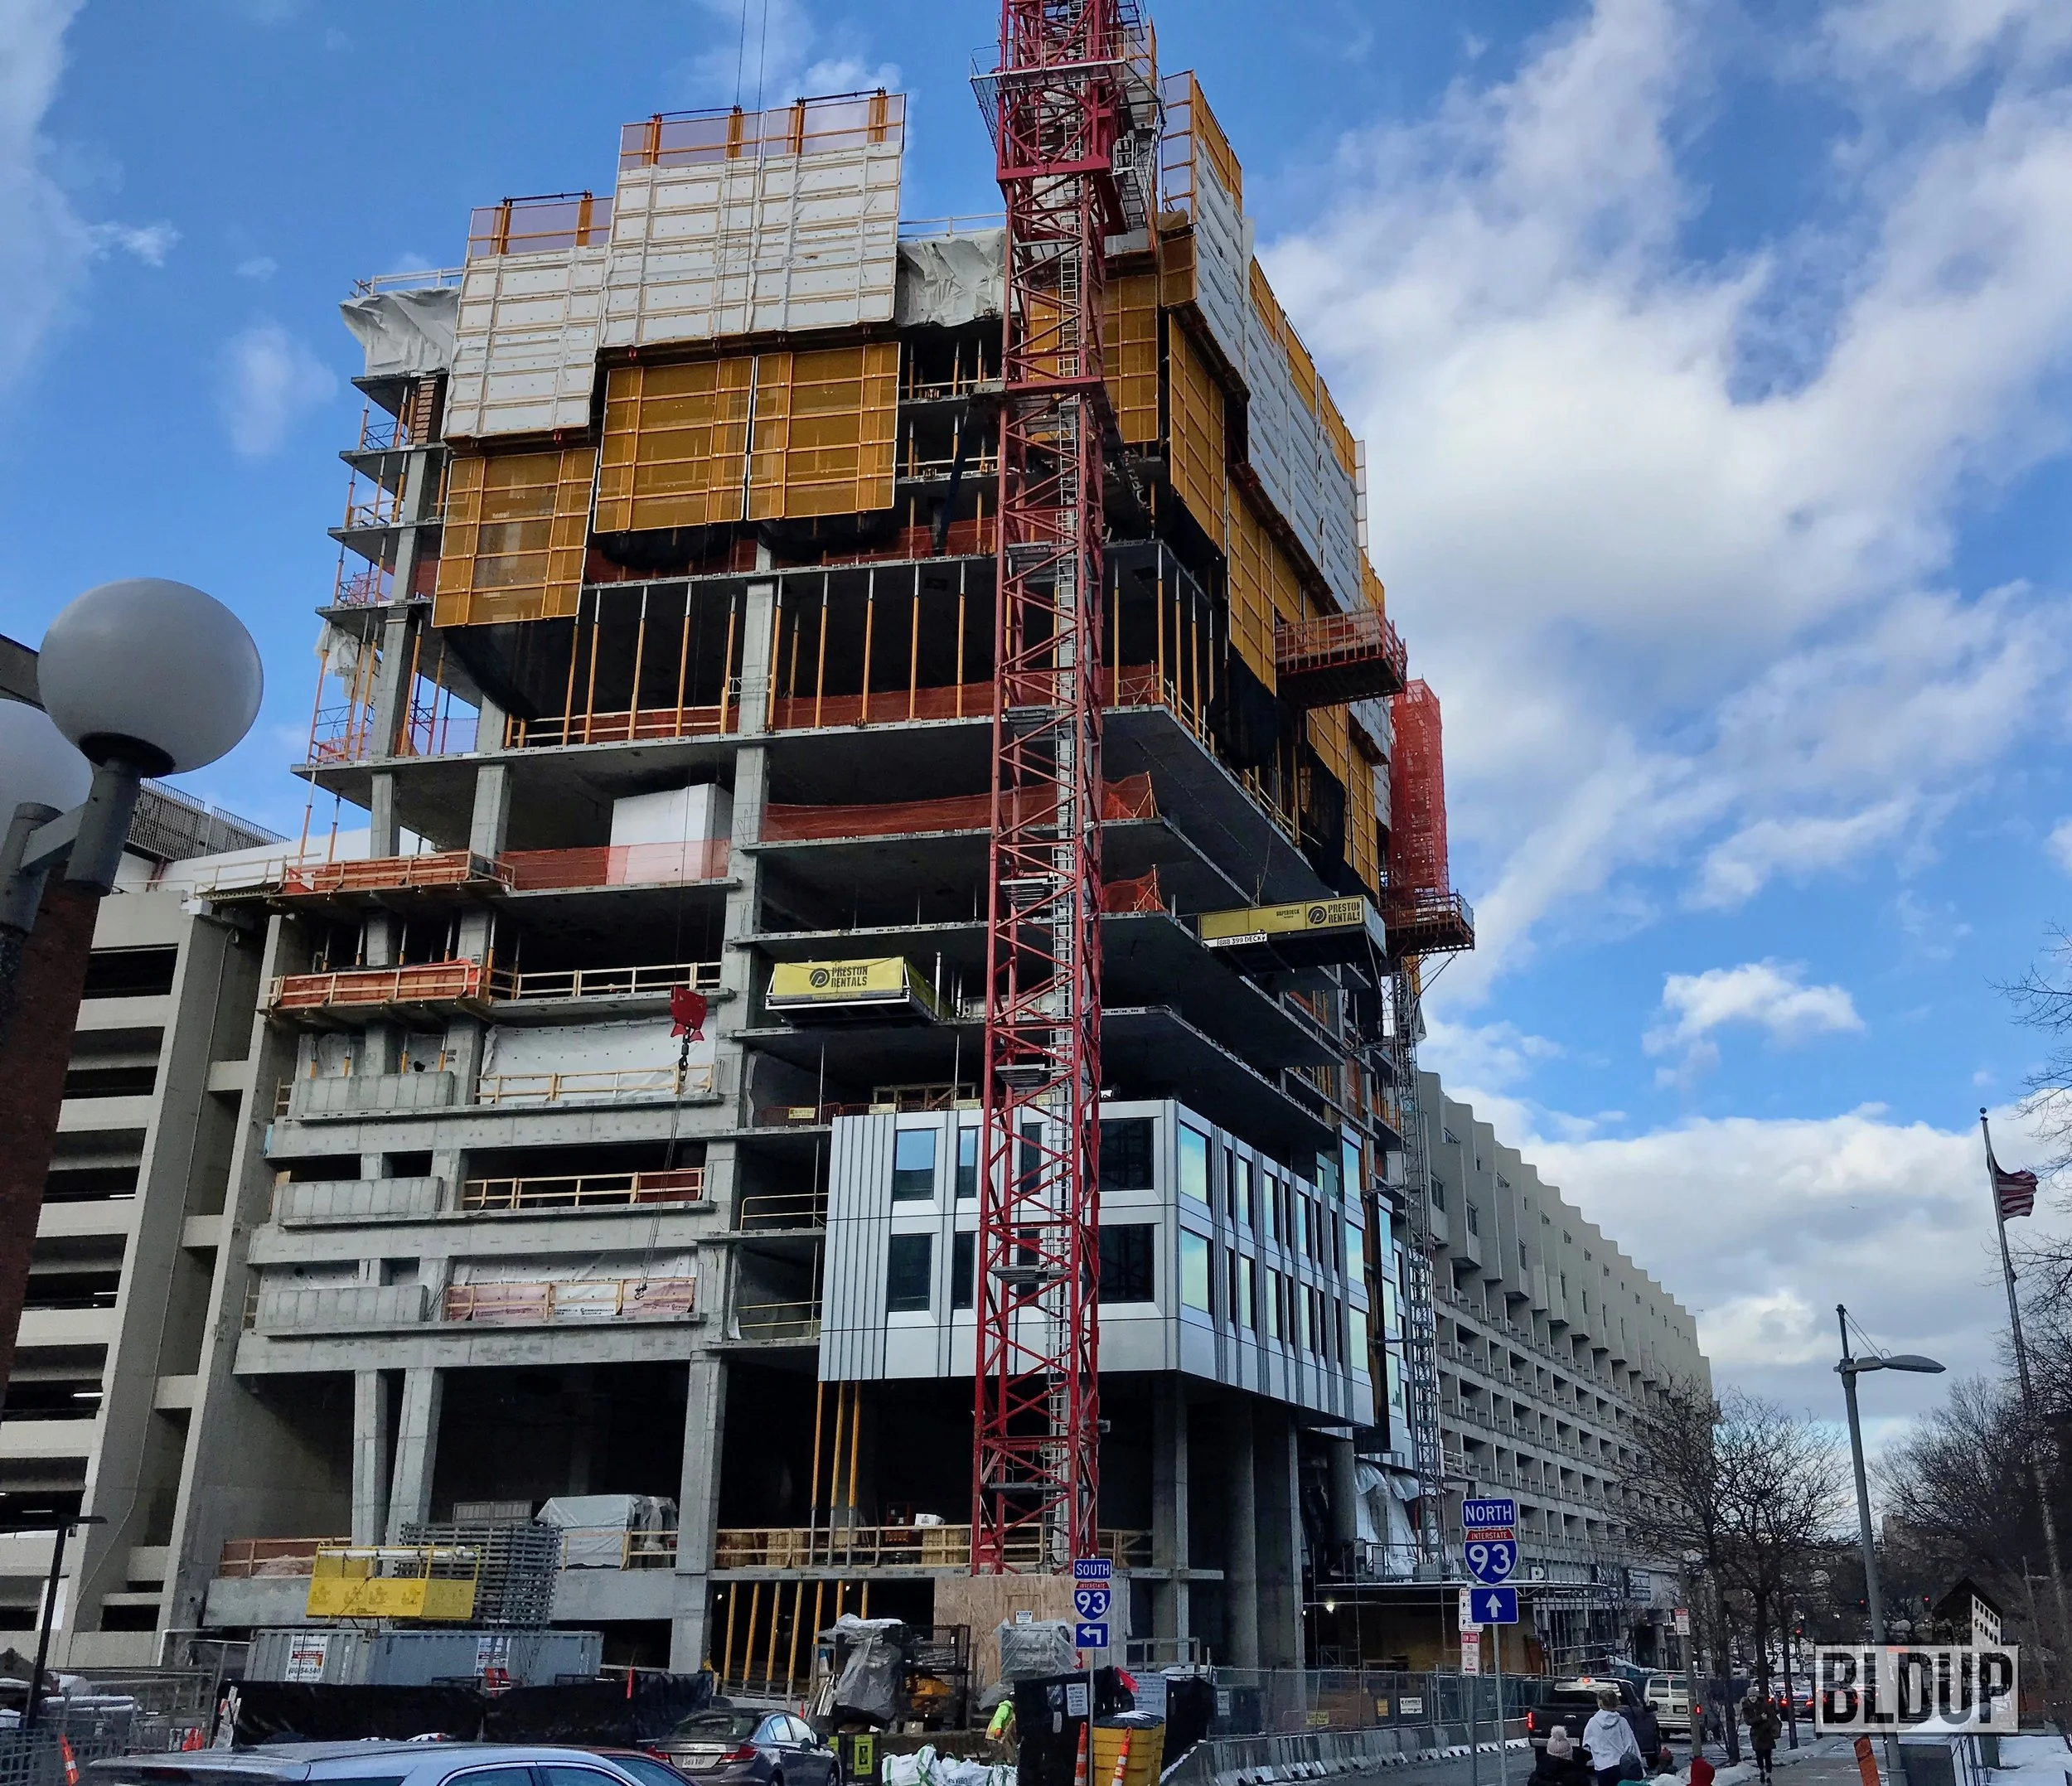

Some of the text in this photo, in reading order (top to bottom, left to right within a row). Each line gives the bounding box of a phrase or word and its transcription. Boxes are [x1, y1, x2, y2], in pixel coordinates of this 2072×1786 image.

[1328, 902, 1360, 913] PRESTON
[1329, 912, 1360, 923] RENTALS
[831, 966, 868, 977] PRESTON
[831, 975, 868, 988] RENTALS
[1464, 1504, 1513, 1522] NORTH
[1471, 1532, 1508, 1540] INTERSTATE
[1469, 1543, 1511, 1575] 93
[1076, 1563, 1110, 1576] SOUTH
[1077, 1591, 1106, 1614] 93
